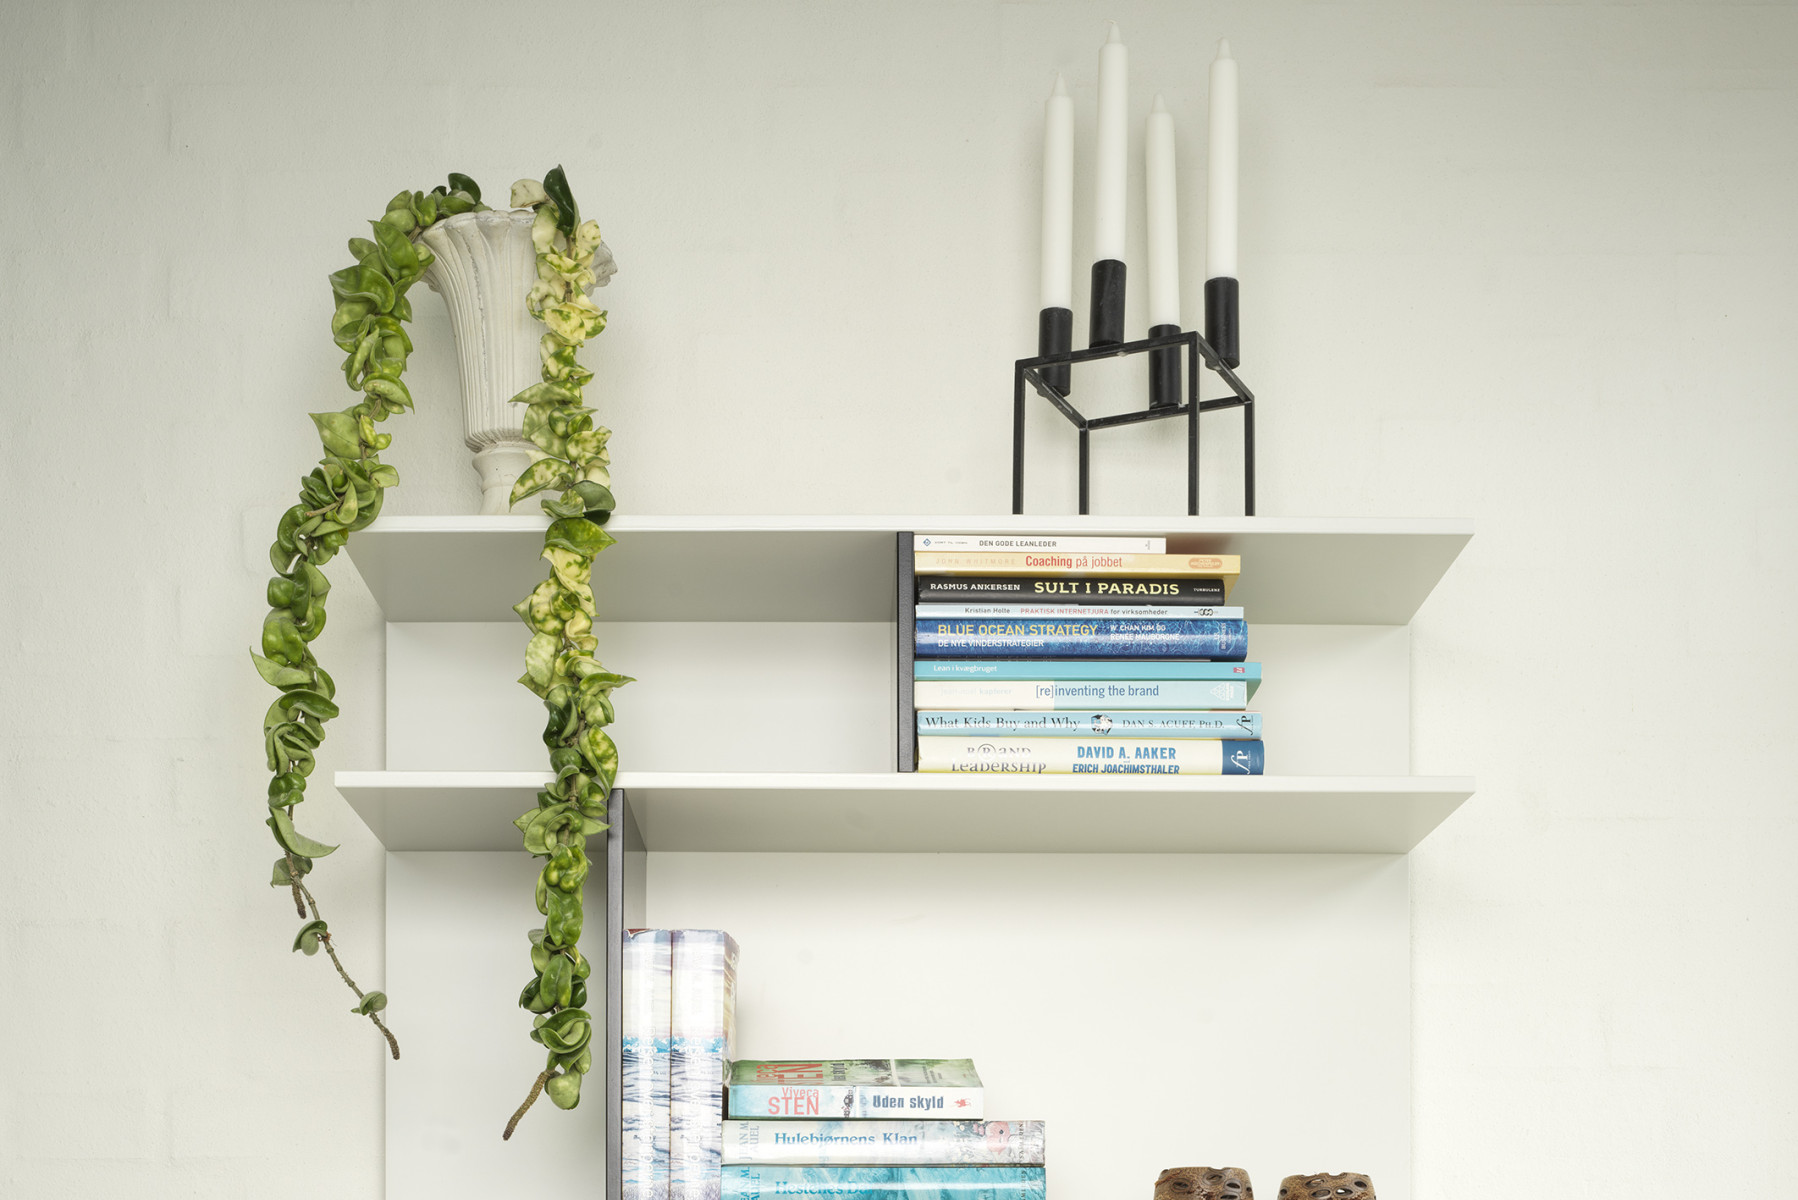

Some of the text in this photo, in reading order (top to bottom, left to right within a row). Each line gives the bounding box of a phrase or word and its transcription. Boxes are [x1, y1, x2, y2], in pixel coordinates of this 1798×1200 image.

[1025, 555, 1123, 569] Coaching på jobbet
[970, 583, 1021, 591] ANKERSEN
[1034, 582, 1180, 595] SULT I PARADIS
[938, 624, 1098, 636] BLUE OCEAN STRATEGY
[933, 664, 951, 672] Lean
[955, 664, 998, 673] kvægbruget
[925, 716, 1081, 731] What Kids Buy and Why
[1077, 746, 1176, 760] DAVID A. AAKER
[1072, 763, 1180, 775] ERICH JOACHIMSTHALER
[781, 1087, 819, 1098] Viveca
[767, 1096, 819, 1115] STEN
[872, 1094, 944, 1110] Uden skyld
[774, 1131, 918, 1148] Hulebjørnens Klan
